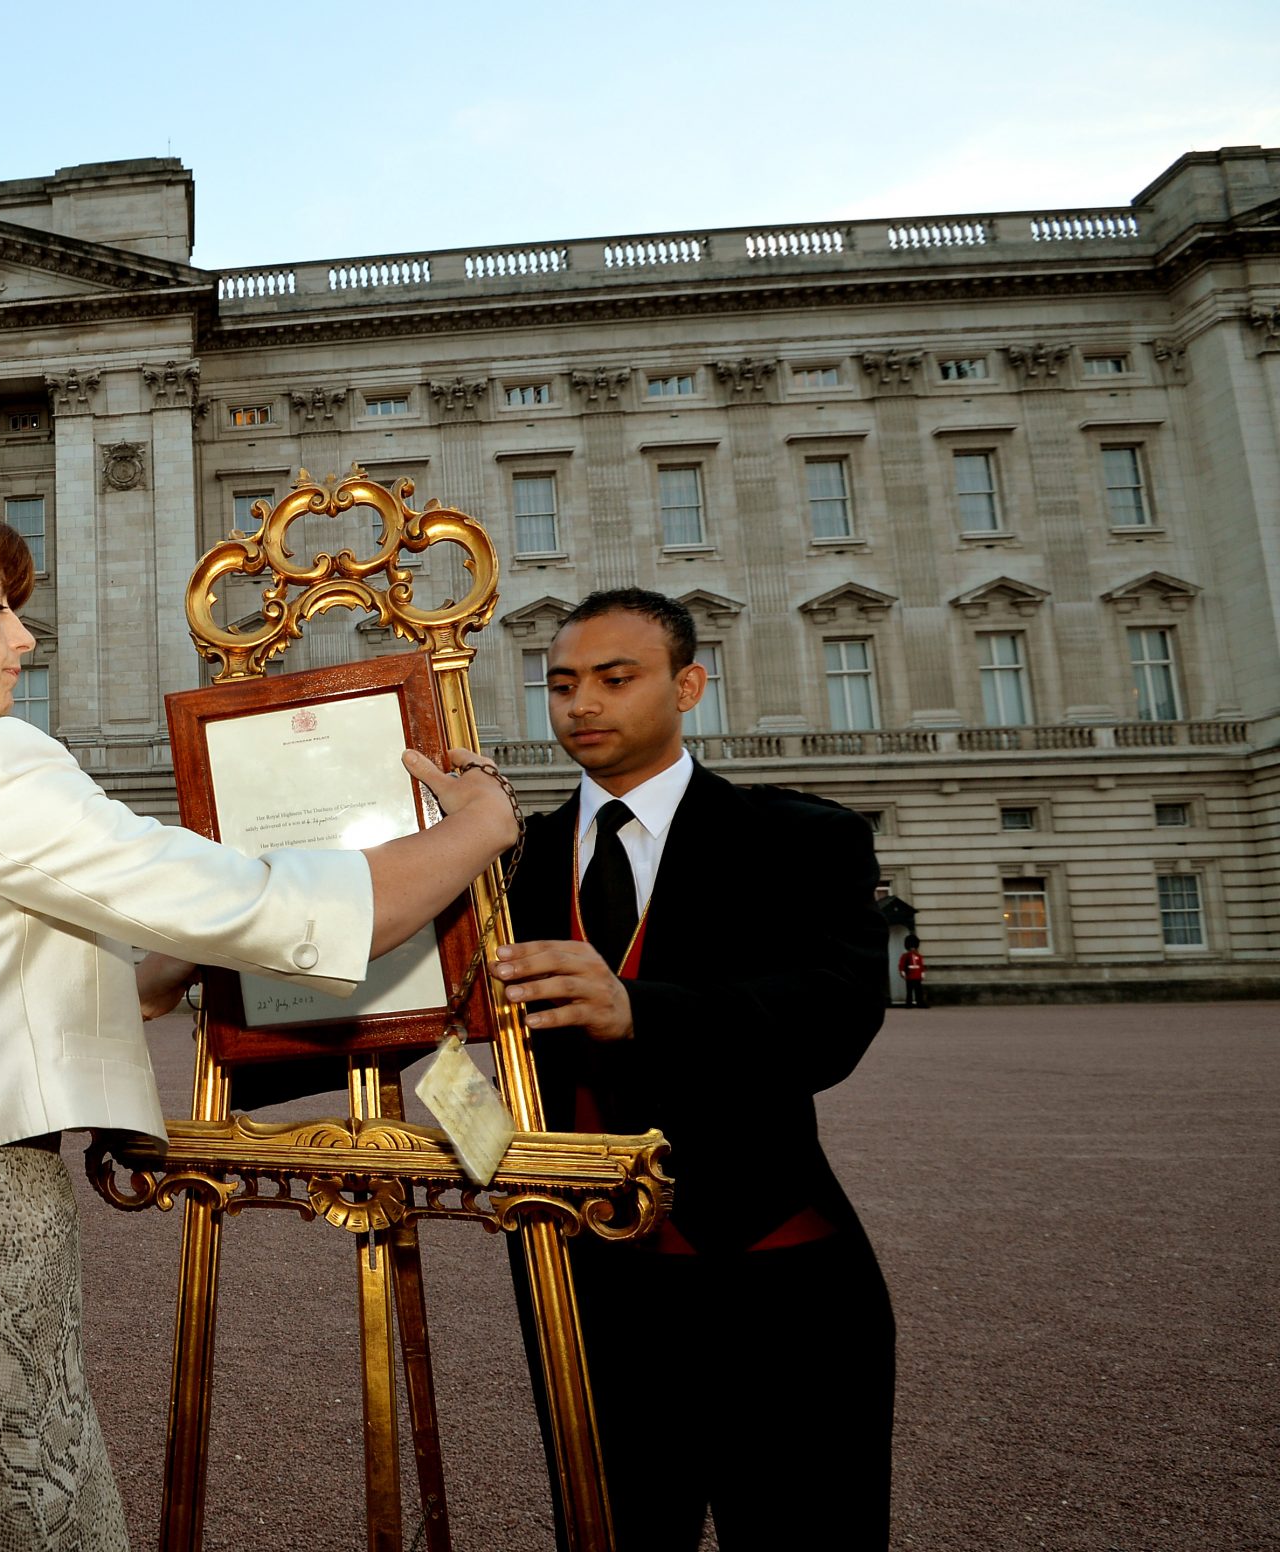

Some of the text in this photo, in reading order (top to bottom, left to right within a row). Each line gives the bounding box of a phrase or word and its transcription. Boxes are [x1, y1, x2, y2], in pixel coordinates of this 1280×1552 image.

[266, 813, 280, 821] Royal
[281, 811, 302, 819] Highness
[339, 802, 366, 810] Cambridge
[270, 839, 284, 848] Royal
[284, 838, 306, 847] Highness
